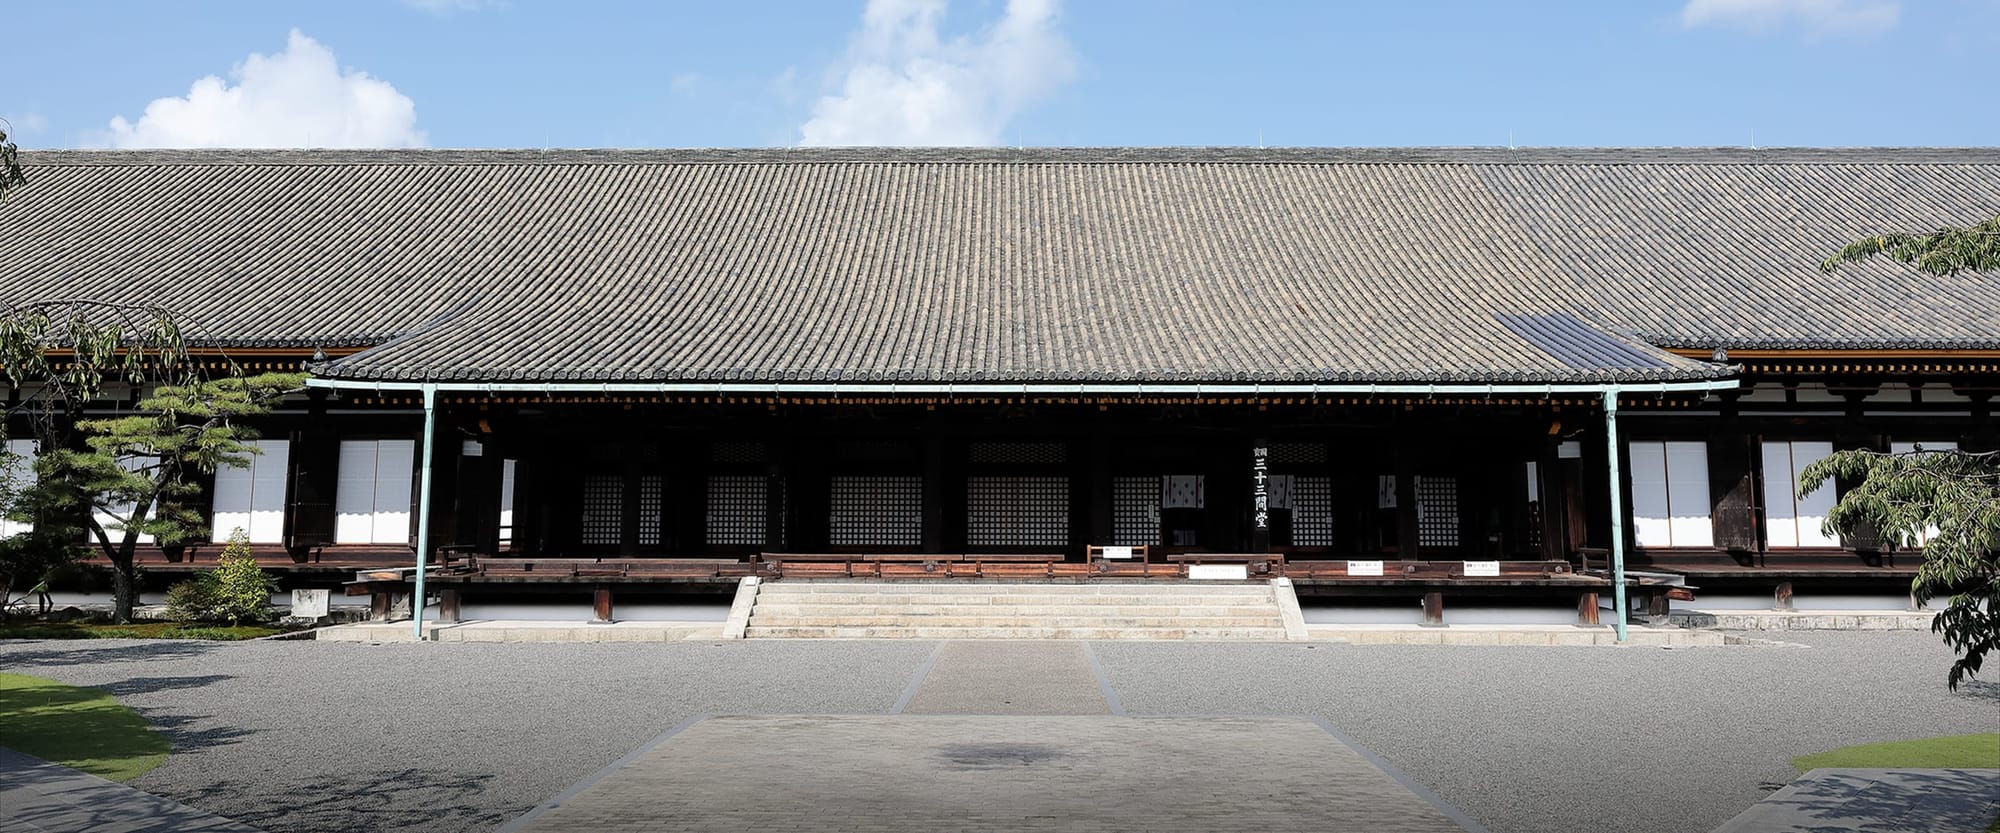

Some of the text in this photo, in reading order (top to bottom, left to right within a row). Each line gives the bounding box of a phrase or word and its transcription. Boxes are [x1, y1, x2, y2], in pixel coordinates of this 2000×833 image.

[1253, 458, 1268, 528] 三十三間堂
